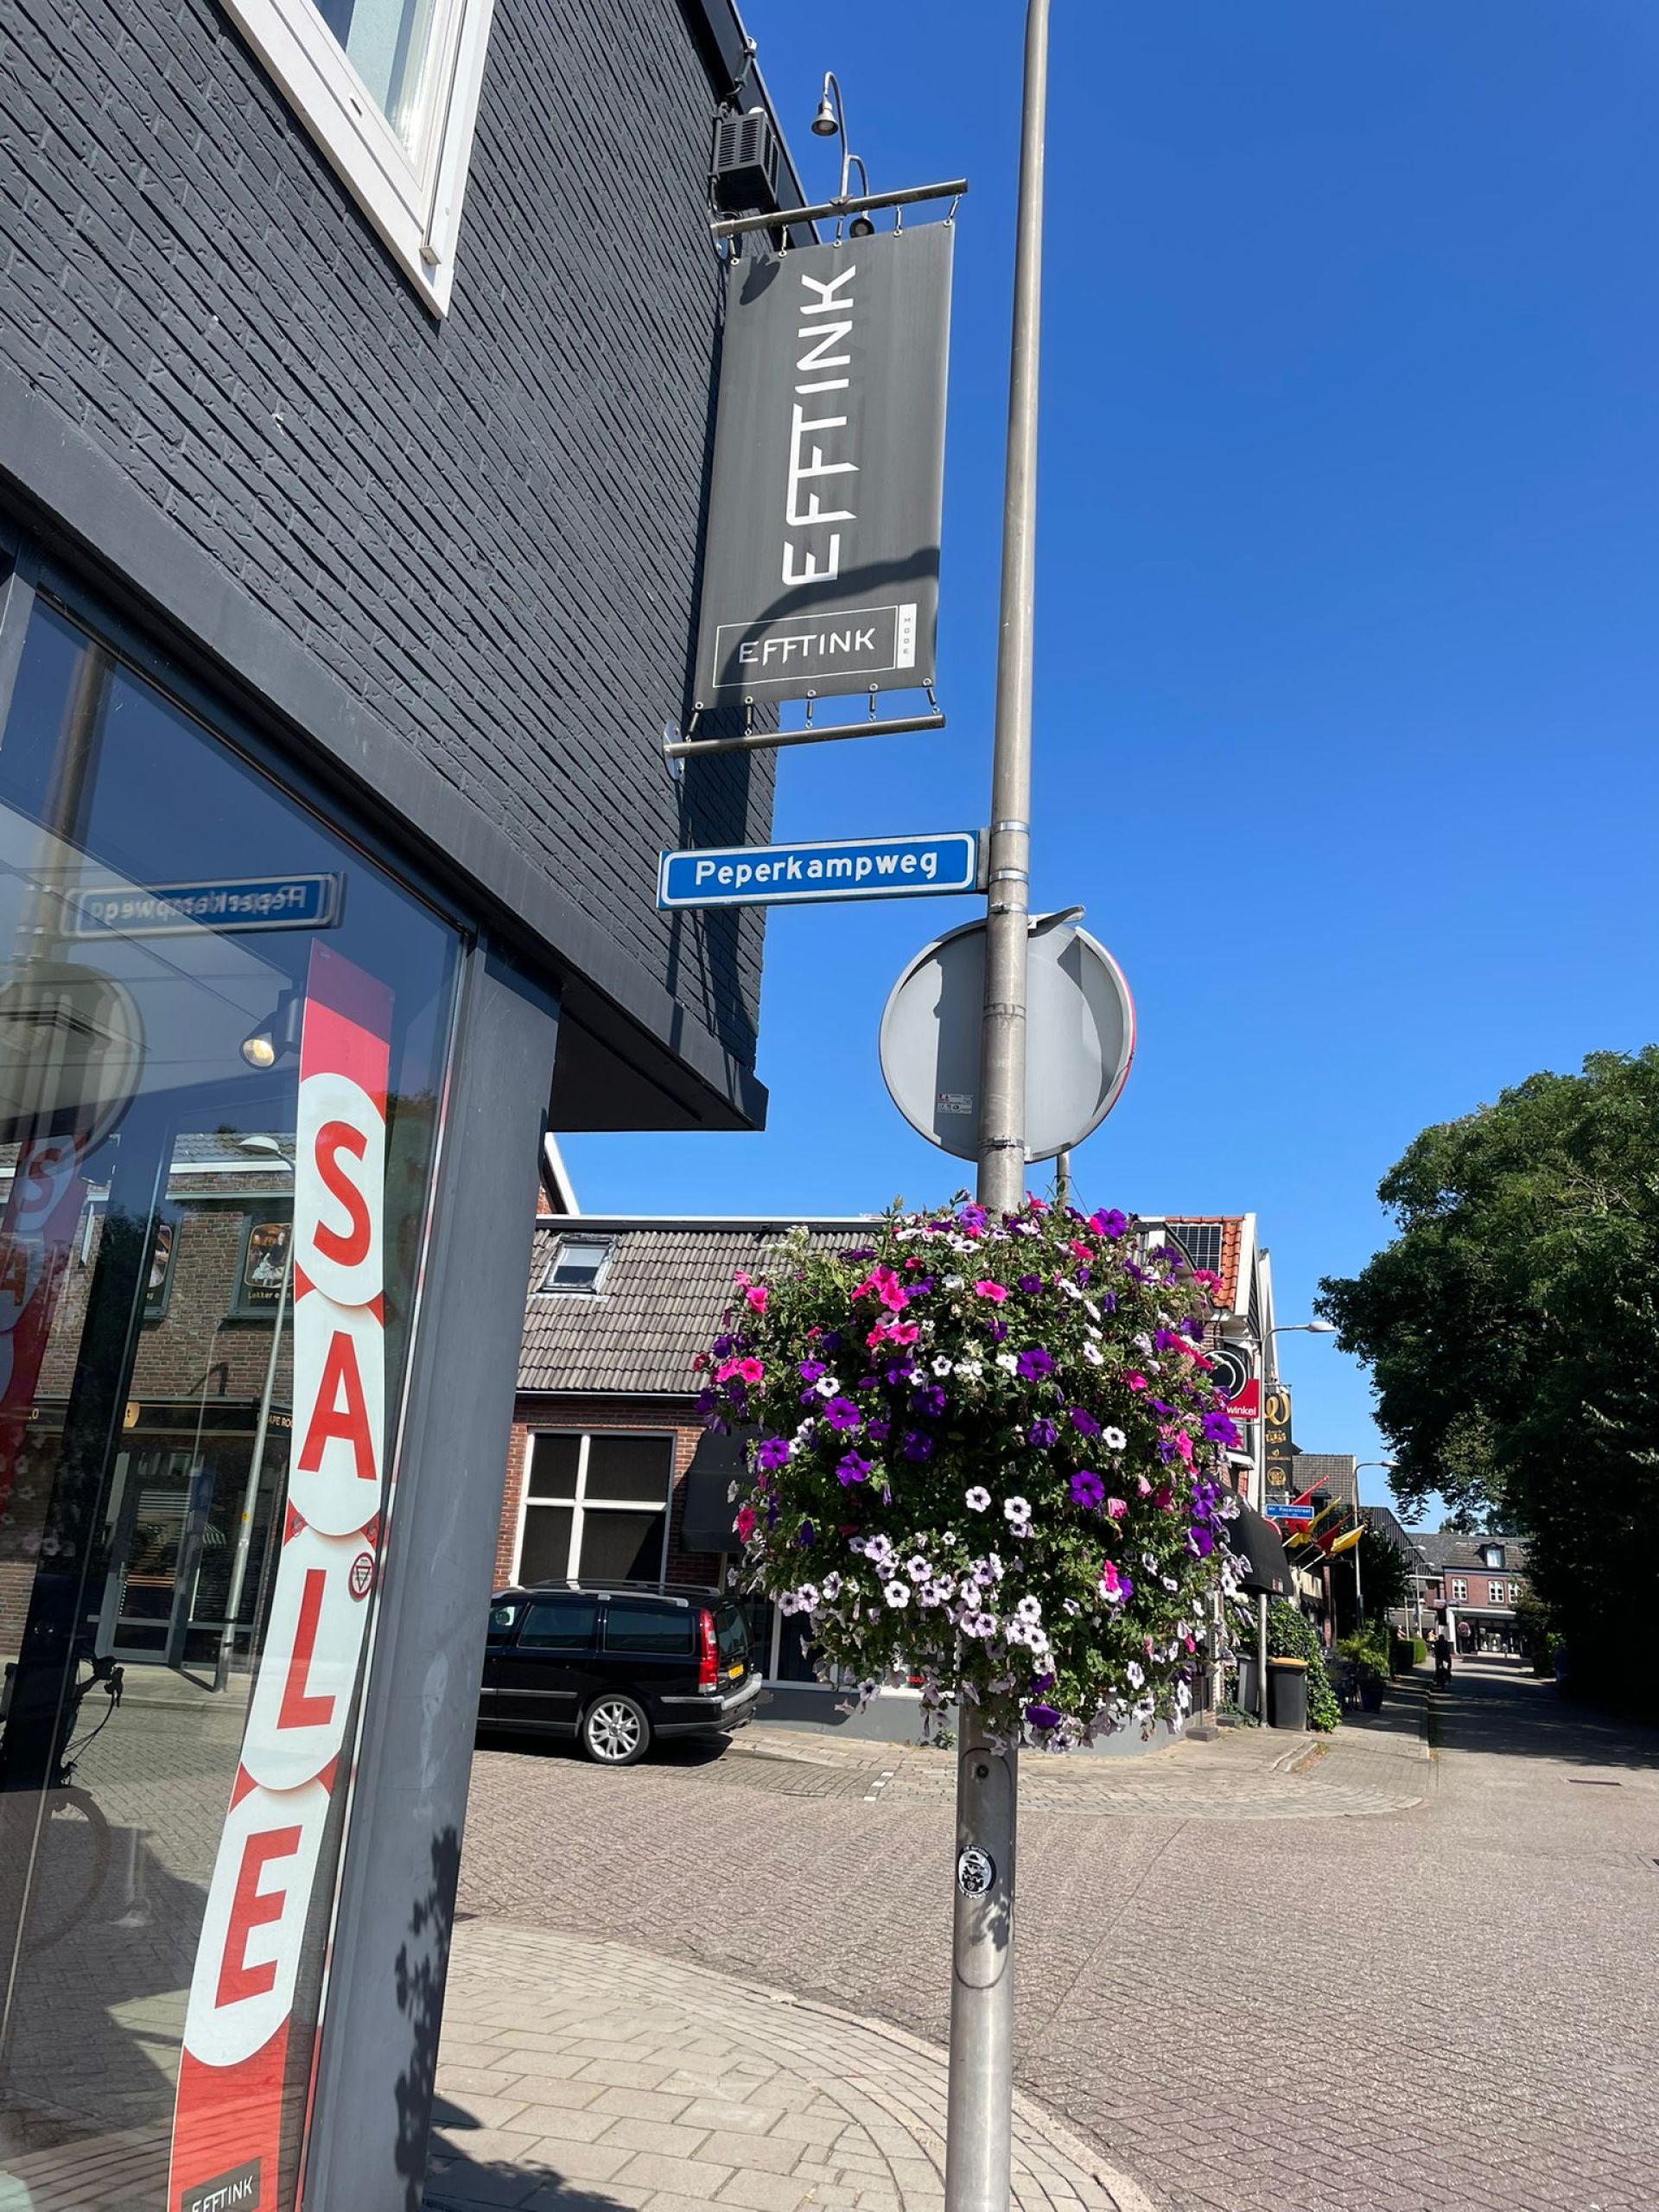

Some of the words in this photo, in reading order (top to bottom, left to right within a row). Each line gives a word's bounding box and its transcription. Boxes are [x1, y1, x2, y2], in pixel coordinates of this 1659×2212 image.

[781, 264, 860, 586] EFFTINK
[739, 627, 876, 666] EFFTINK
[696, 852, 938, 888] Peperkampweg
[1226, 1405, 1256, 1416] winkel
[214, 1121, 378, 2009] SALE
